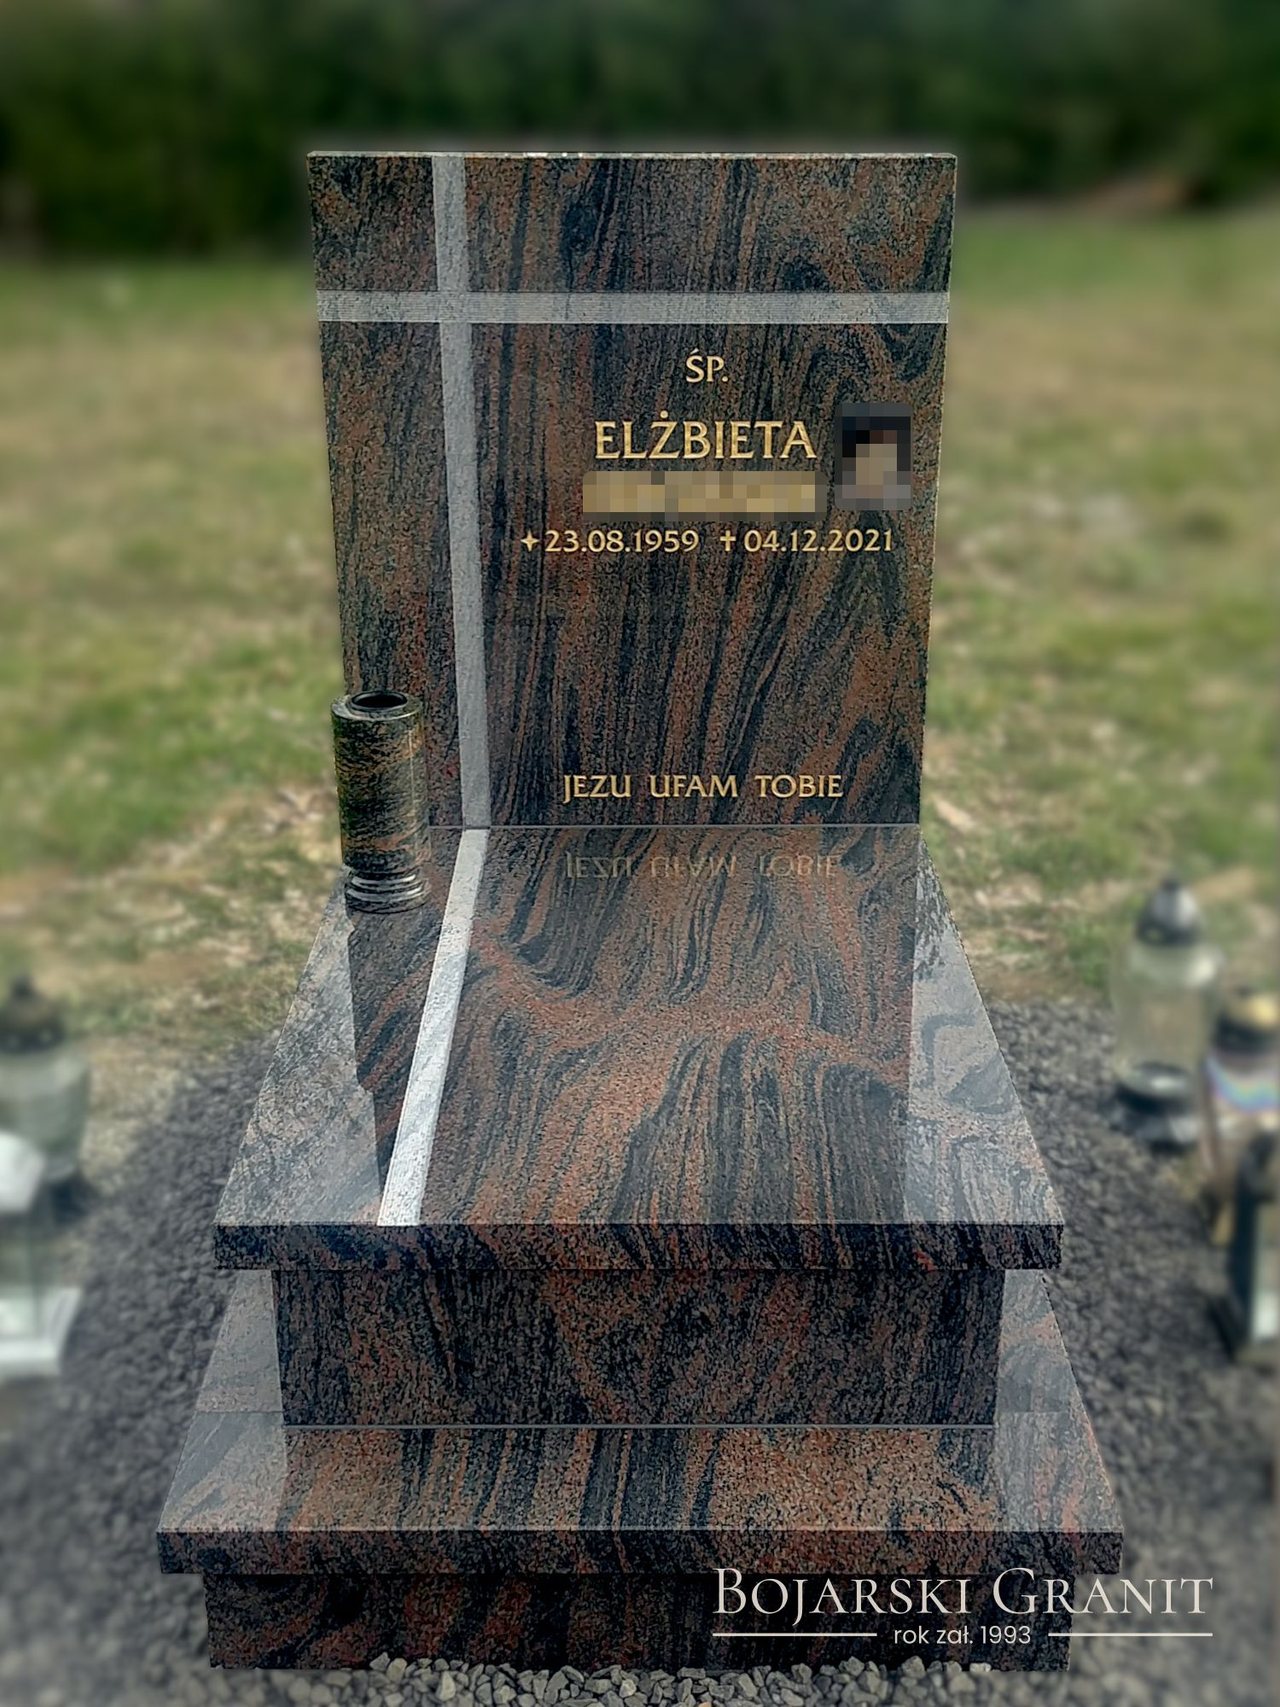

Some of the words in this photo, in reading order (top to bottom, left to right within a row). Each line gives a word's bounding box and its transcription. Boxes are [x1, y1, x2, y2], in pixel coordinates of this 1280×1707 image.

[685, 348, 729, 383] ŚP.
[595, 410, 818, 460] ELŻBIETA
[545, 529, 700, 553] 23.08.1959
[743, 529, 893, 553] 04.12.2021
[563, 774, 632, 804] JEZU
[650, 774, 739, 798] UFAM
[754, 774, 844, 798] TOBIE
